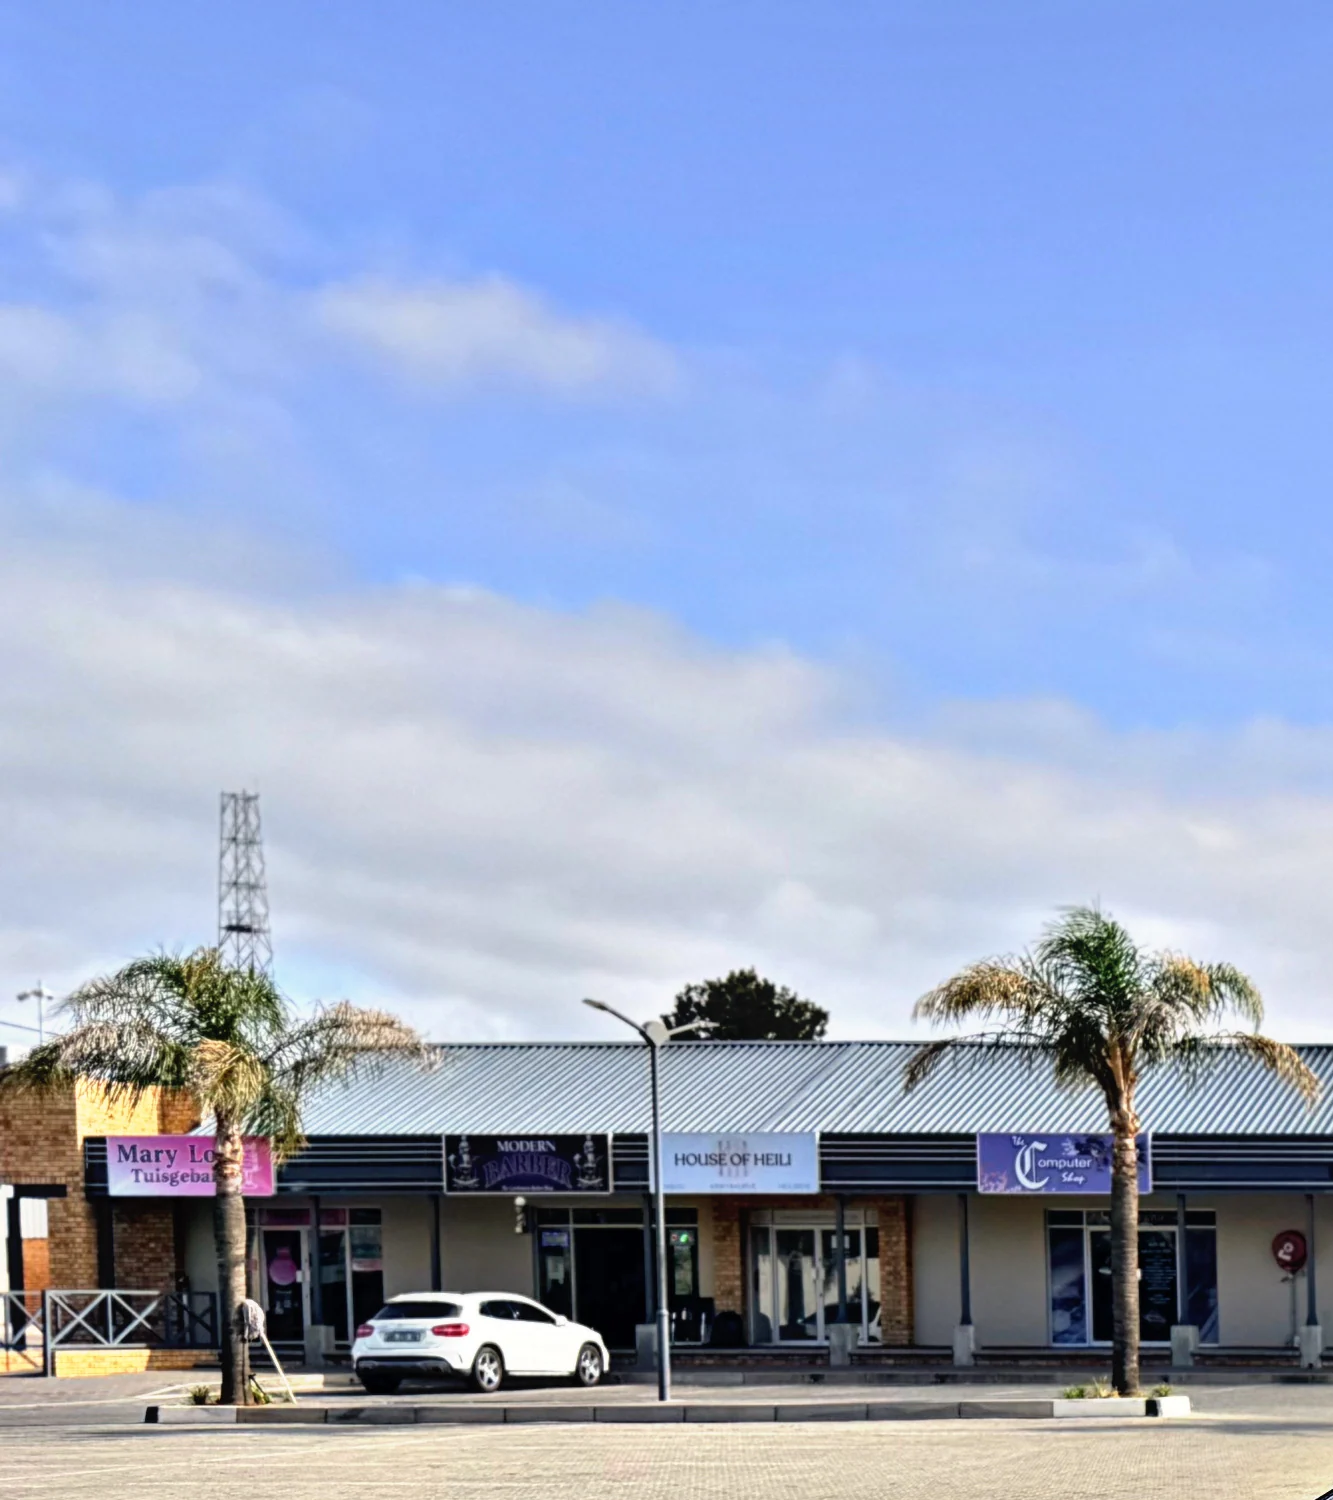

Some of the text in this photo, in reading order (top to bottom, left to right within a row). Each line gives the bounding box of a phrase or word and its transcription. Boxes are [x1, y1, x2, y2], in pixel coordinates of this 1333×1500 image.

[497, 1140, 557, 1152] MODERN
[117, 1144, 178, 1168] Mary
[674, 1153, 792, 1167] HOUSE OF HEILI
[131, 1168, 217, 1186] Tuisgeba
[483, 1153, 573, 1189] BARBER
[1061, 1172, 1085, 1185] Shop
